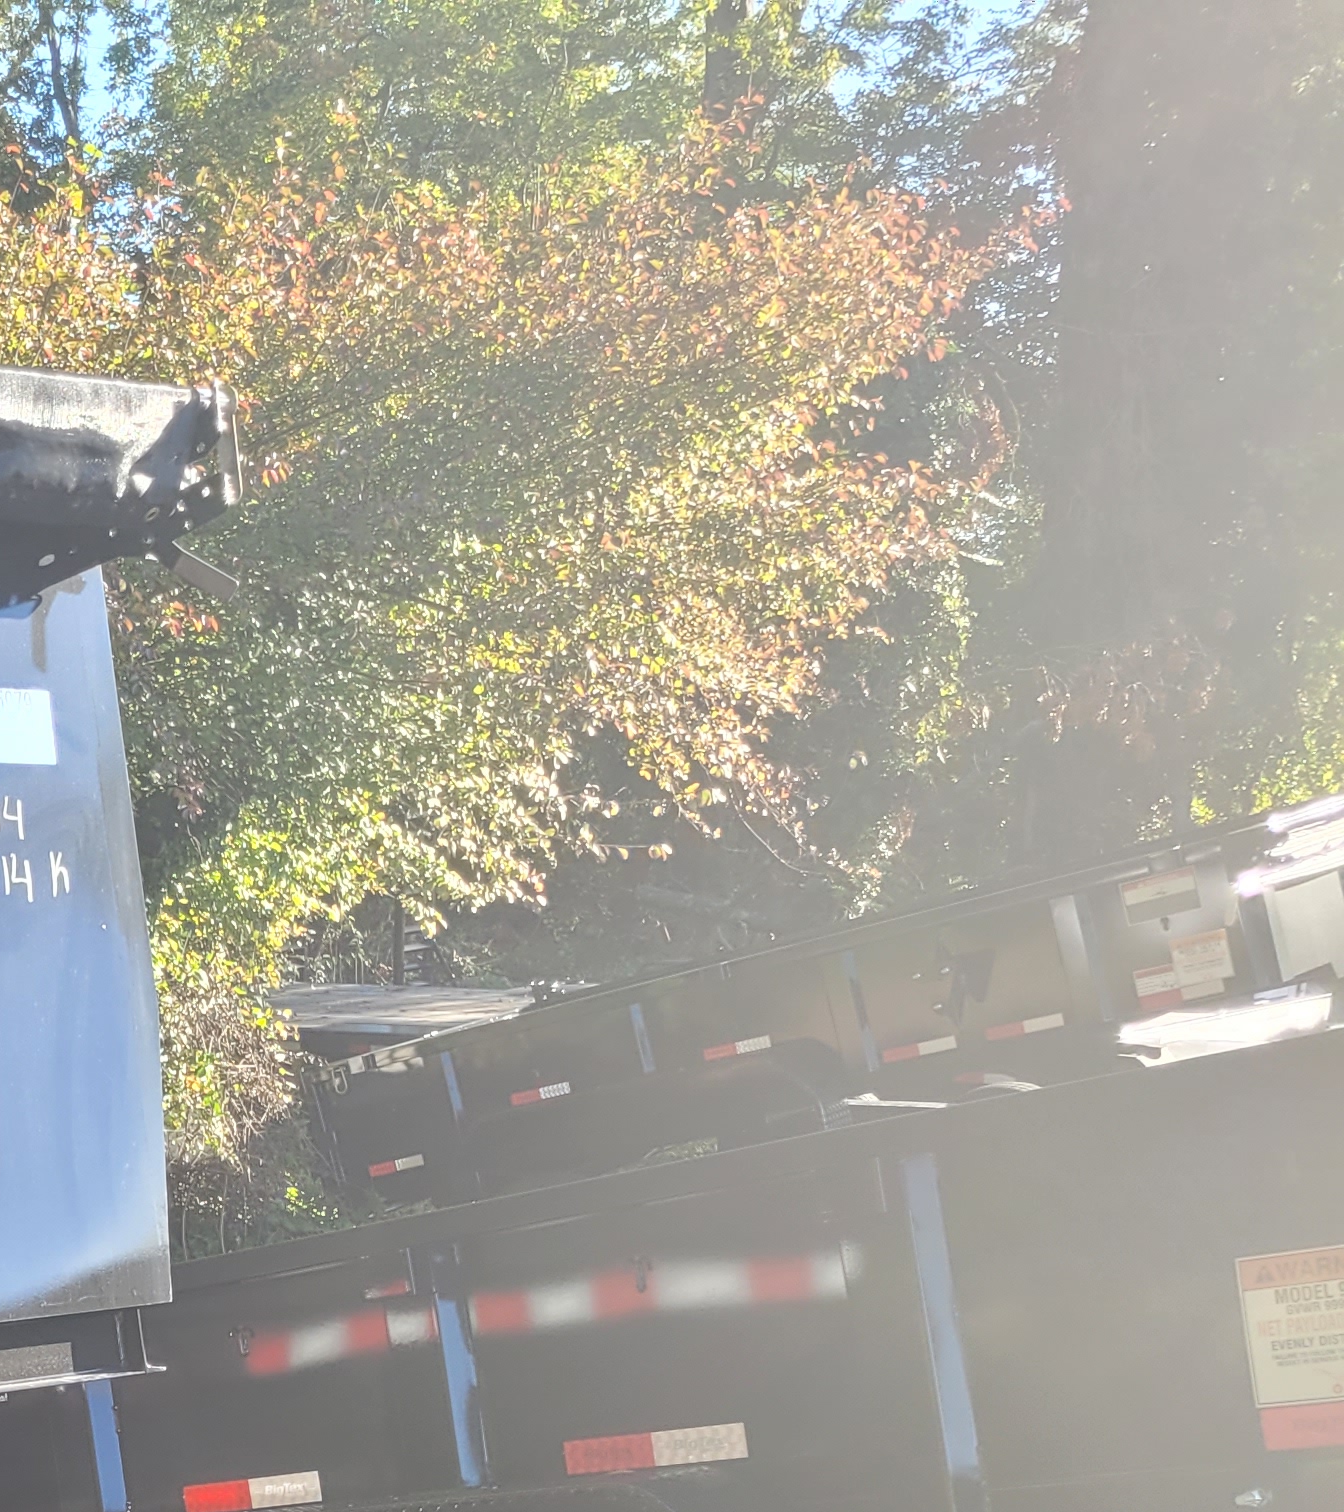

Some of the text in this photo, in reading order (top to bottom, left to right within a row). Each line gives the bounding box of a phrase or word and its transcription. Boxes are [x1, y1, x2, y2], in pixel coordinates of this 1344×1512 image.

[1, 853, 34, 903] 14
[1274, 1283, 1334, 1304] MODEL
[1270, 1337, 1313, 1351] EVENLY
